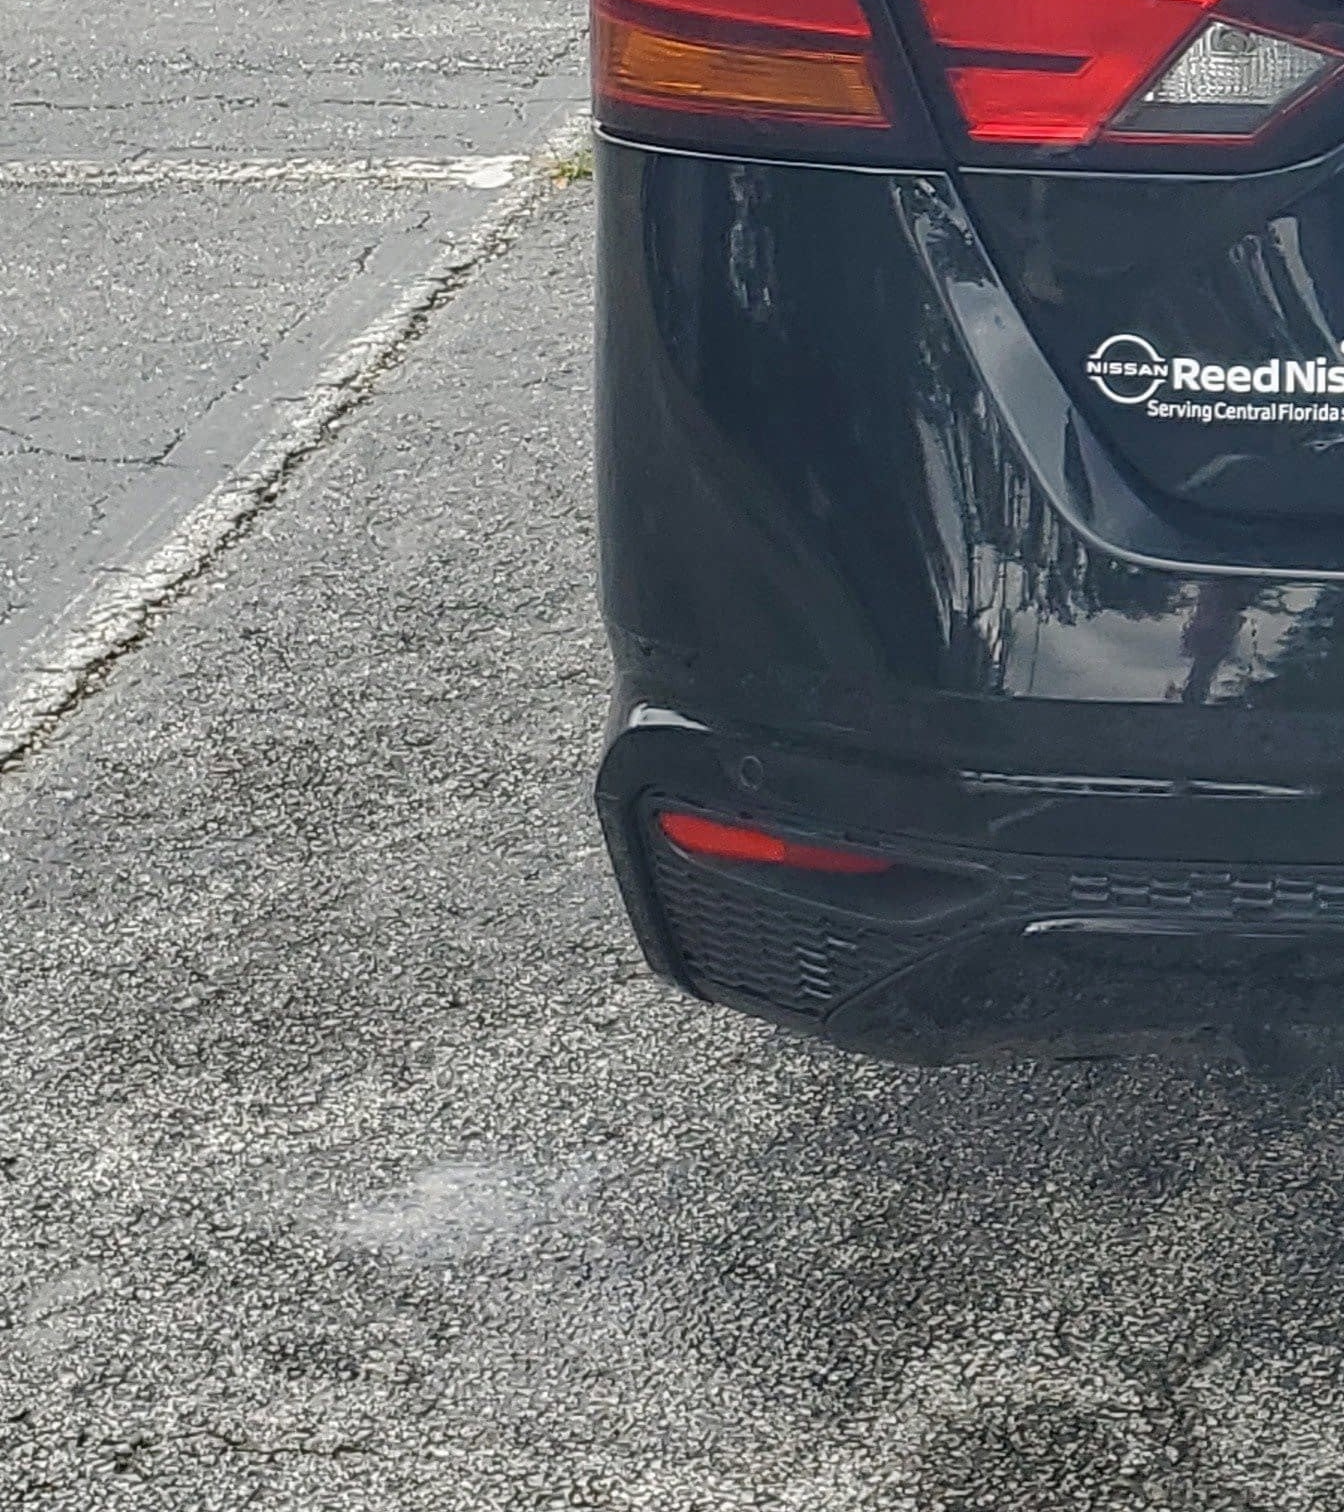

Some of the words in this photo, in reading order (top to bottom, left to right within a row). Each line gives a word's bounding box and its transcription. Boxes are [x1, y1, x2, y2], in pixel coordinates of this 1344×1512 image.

[1086, 361, 1169, 377] NISSAN
[1147, 399, 1212, 423] Serving
[1214, 402, 1276, 420] Central
[1278, 403, 1339, 420] Florida
